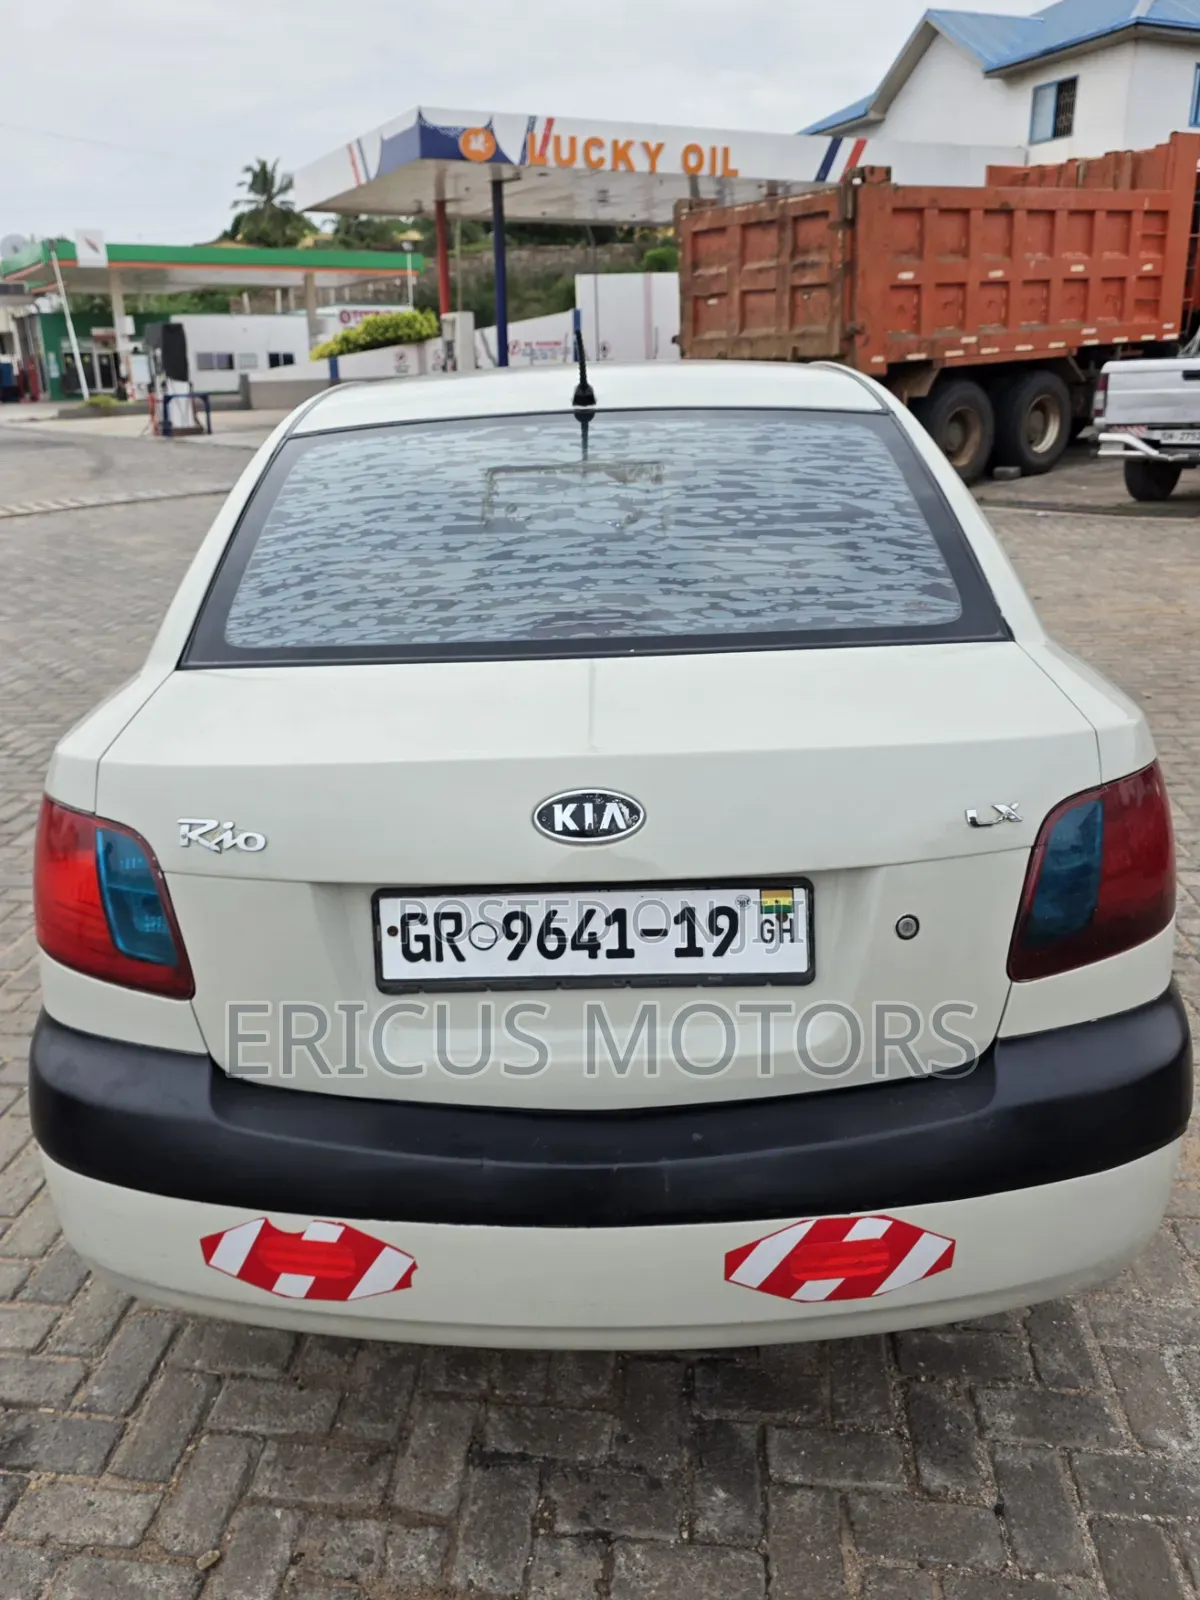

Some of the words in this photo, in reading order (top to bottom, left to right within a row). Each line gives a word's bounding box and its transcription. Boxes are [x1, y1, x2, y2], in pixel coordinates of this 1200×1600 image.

[527, 131, 665, 174] LUCKY
[681, 143, 739, 177] OIL
[552, 802, 627, 831] KIA
[965, 803, 1023, 828] LX
[177, 818, 267, 853] Rio
[400, 911, 466, 962] GR
[502, 906, 738, 961] 9641-19
[760, 918, 794, 943] GH
